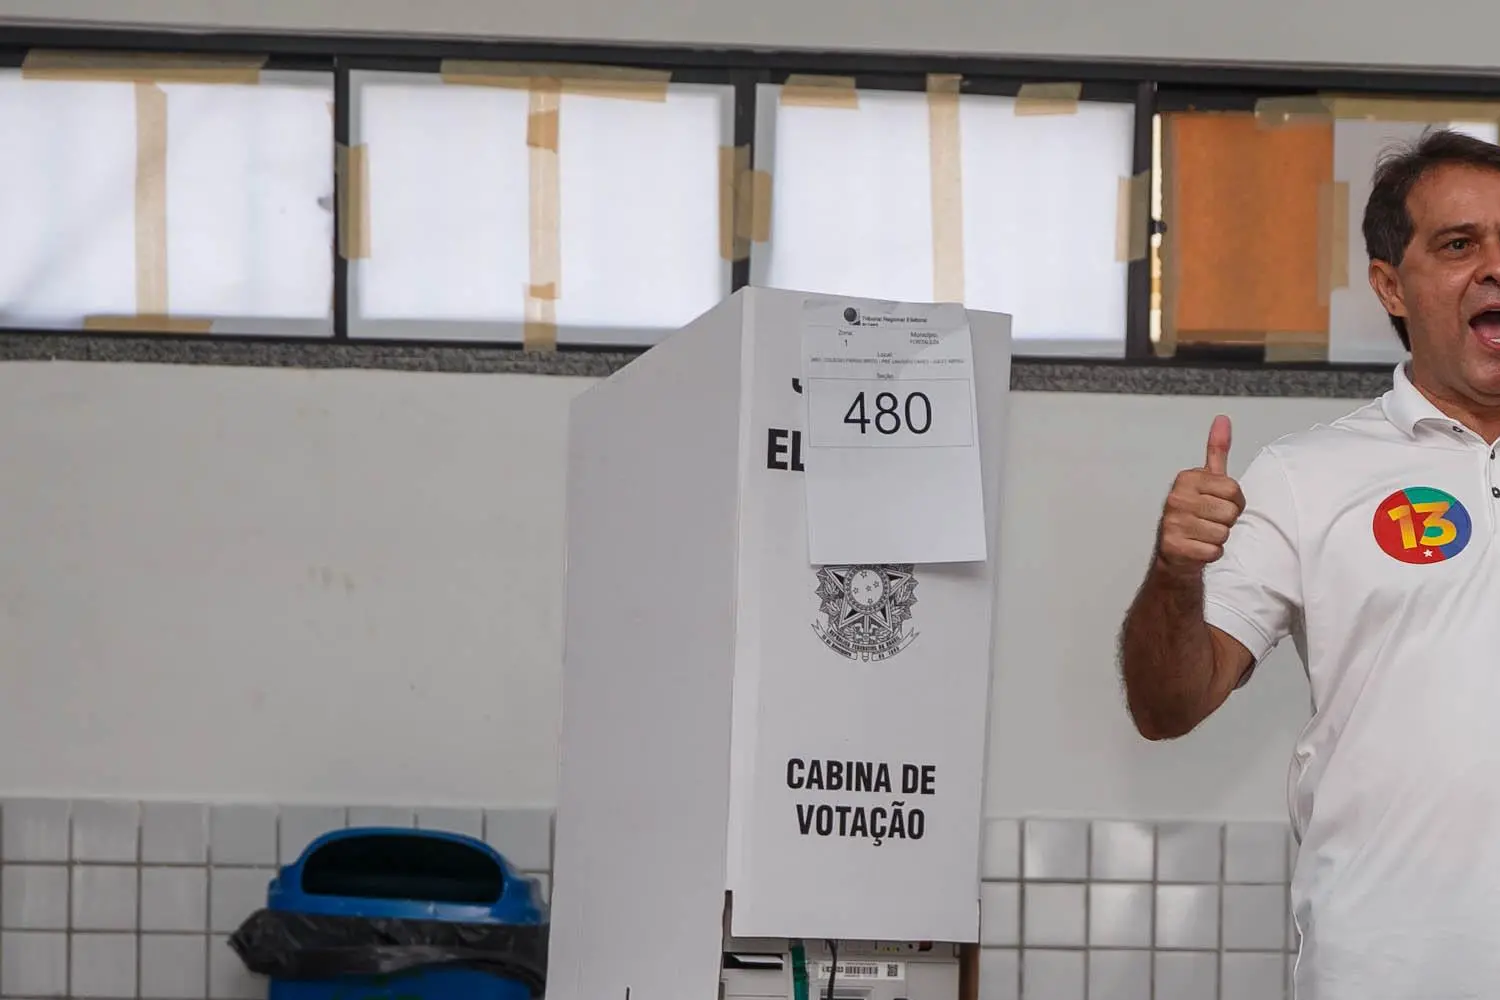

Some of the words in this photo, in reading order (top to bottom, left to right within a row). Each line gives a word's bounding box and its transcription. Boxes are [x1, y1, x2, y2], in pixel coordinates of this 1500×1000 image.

[843, 391, 932, 435] 480
[1387, 500, 1457, 550] 13
[786, 757, 892, 793] CABINA
[901, 763, 936, 795] DE
[795, 801, 925, 847] VOTAÇÃO
